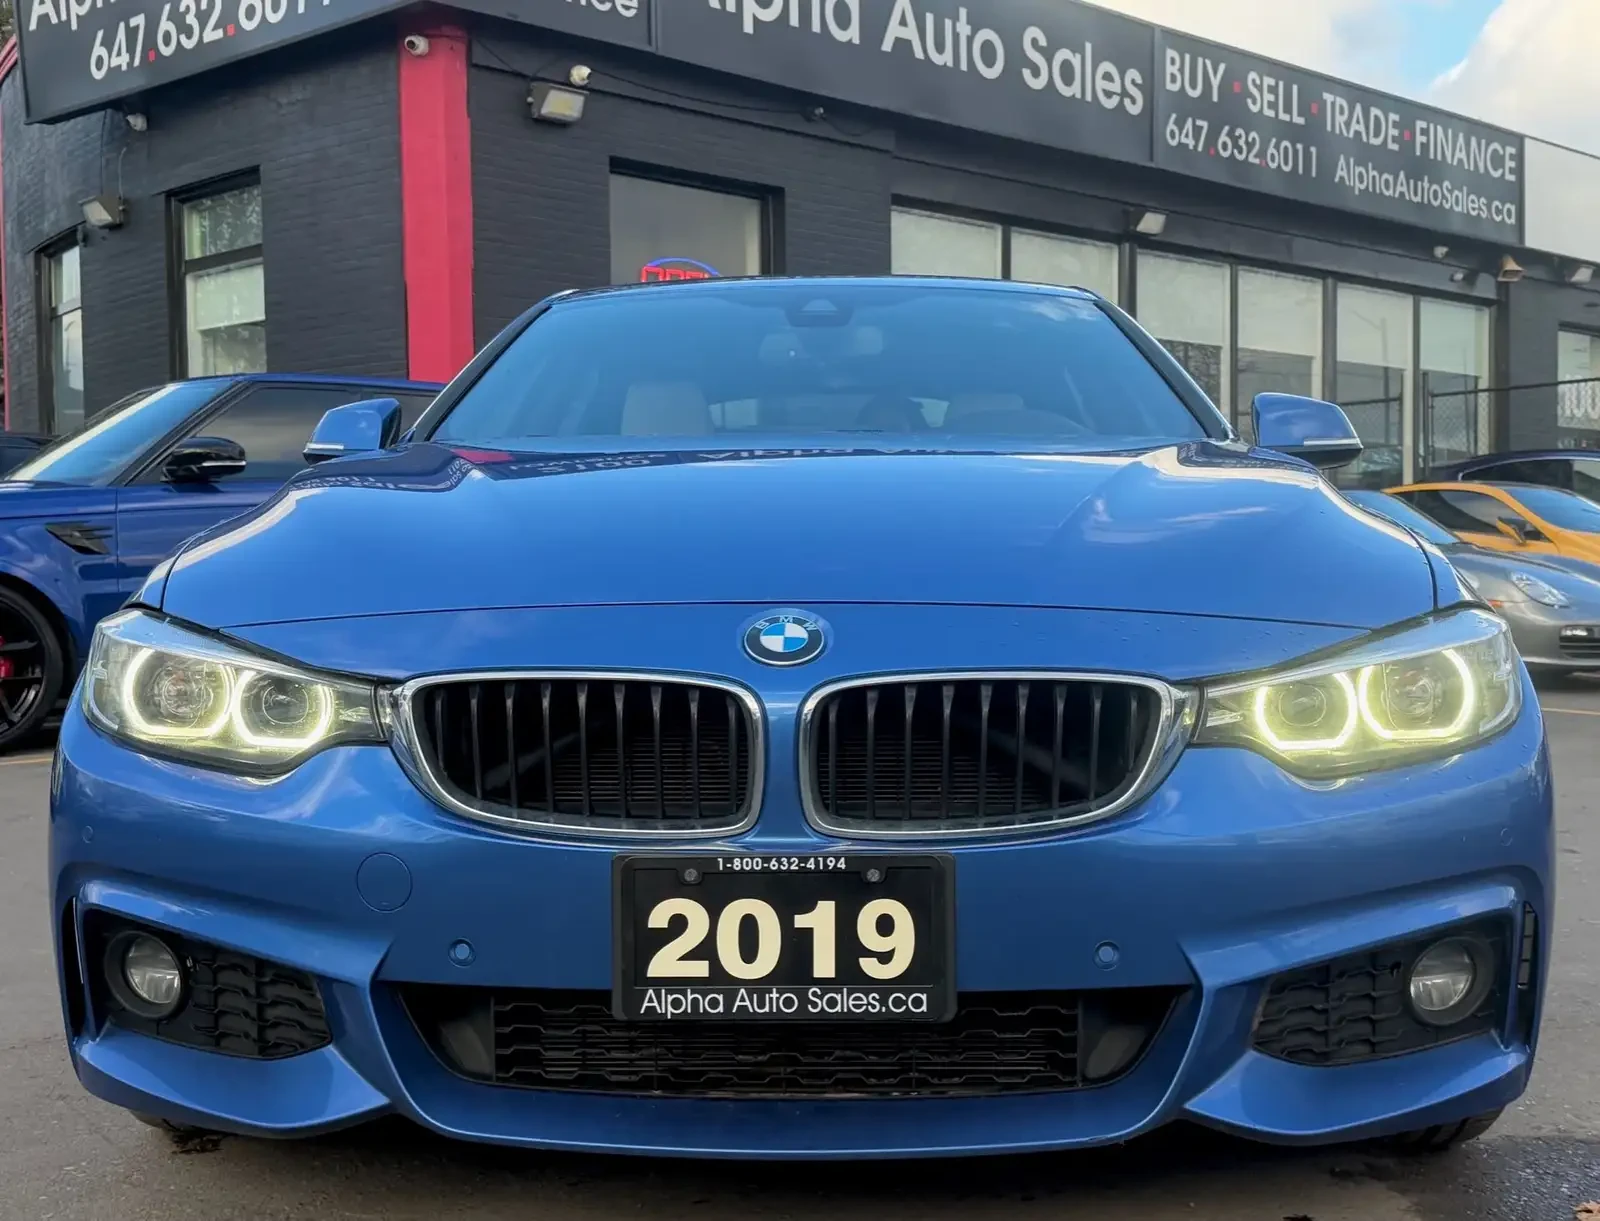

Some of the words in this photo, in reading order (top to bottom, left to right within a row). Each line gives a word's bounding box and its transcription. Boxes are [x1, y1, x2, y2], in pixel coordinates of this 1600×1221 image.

[881, 0, 1005, 80] Auto
[1022, 26, 1144, 116] Sales
[1164, 47, 1226, 103] BUY
[1246, 70, 1306, 126] SELL
[1322, 92, 1400, 152] TRADE
[1415, 119, 1517, 183] FINANCE
[1165, 112, 1318, 179] 647.632.6011
[1334, 153, 1517, 226] AlphaAutoSales.ca
[754, 614, 818, 632] BMW
[716, 857, 847, 871] 1-800-632-4194
[646, 897, 916, 980] 2019
[640, 988, 724, 1019] Alpha
[732, 988, 799, 1013] Auto
[807, 987, 928, 1013] Sales.ca
